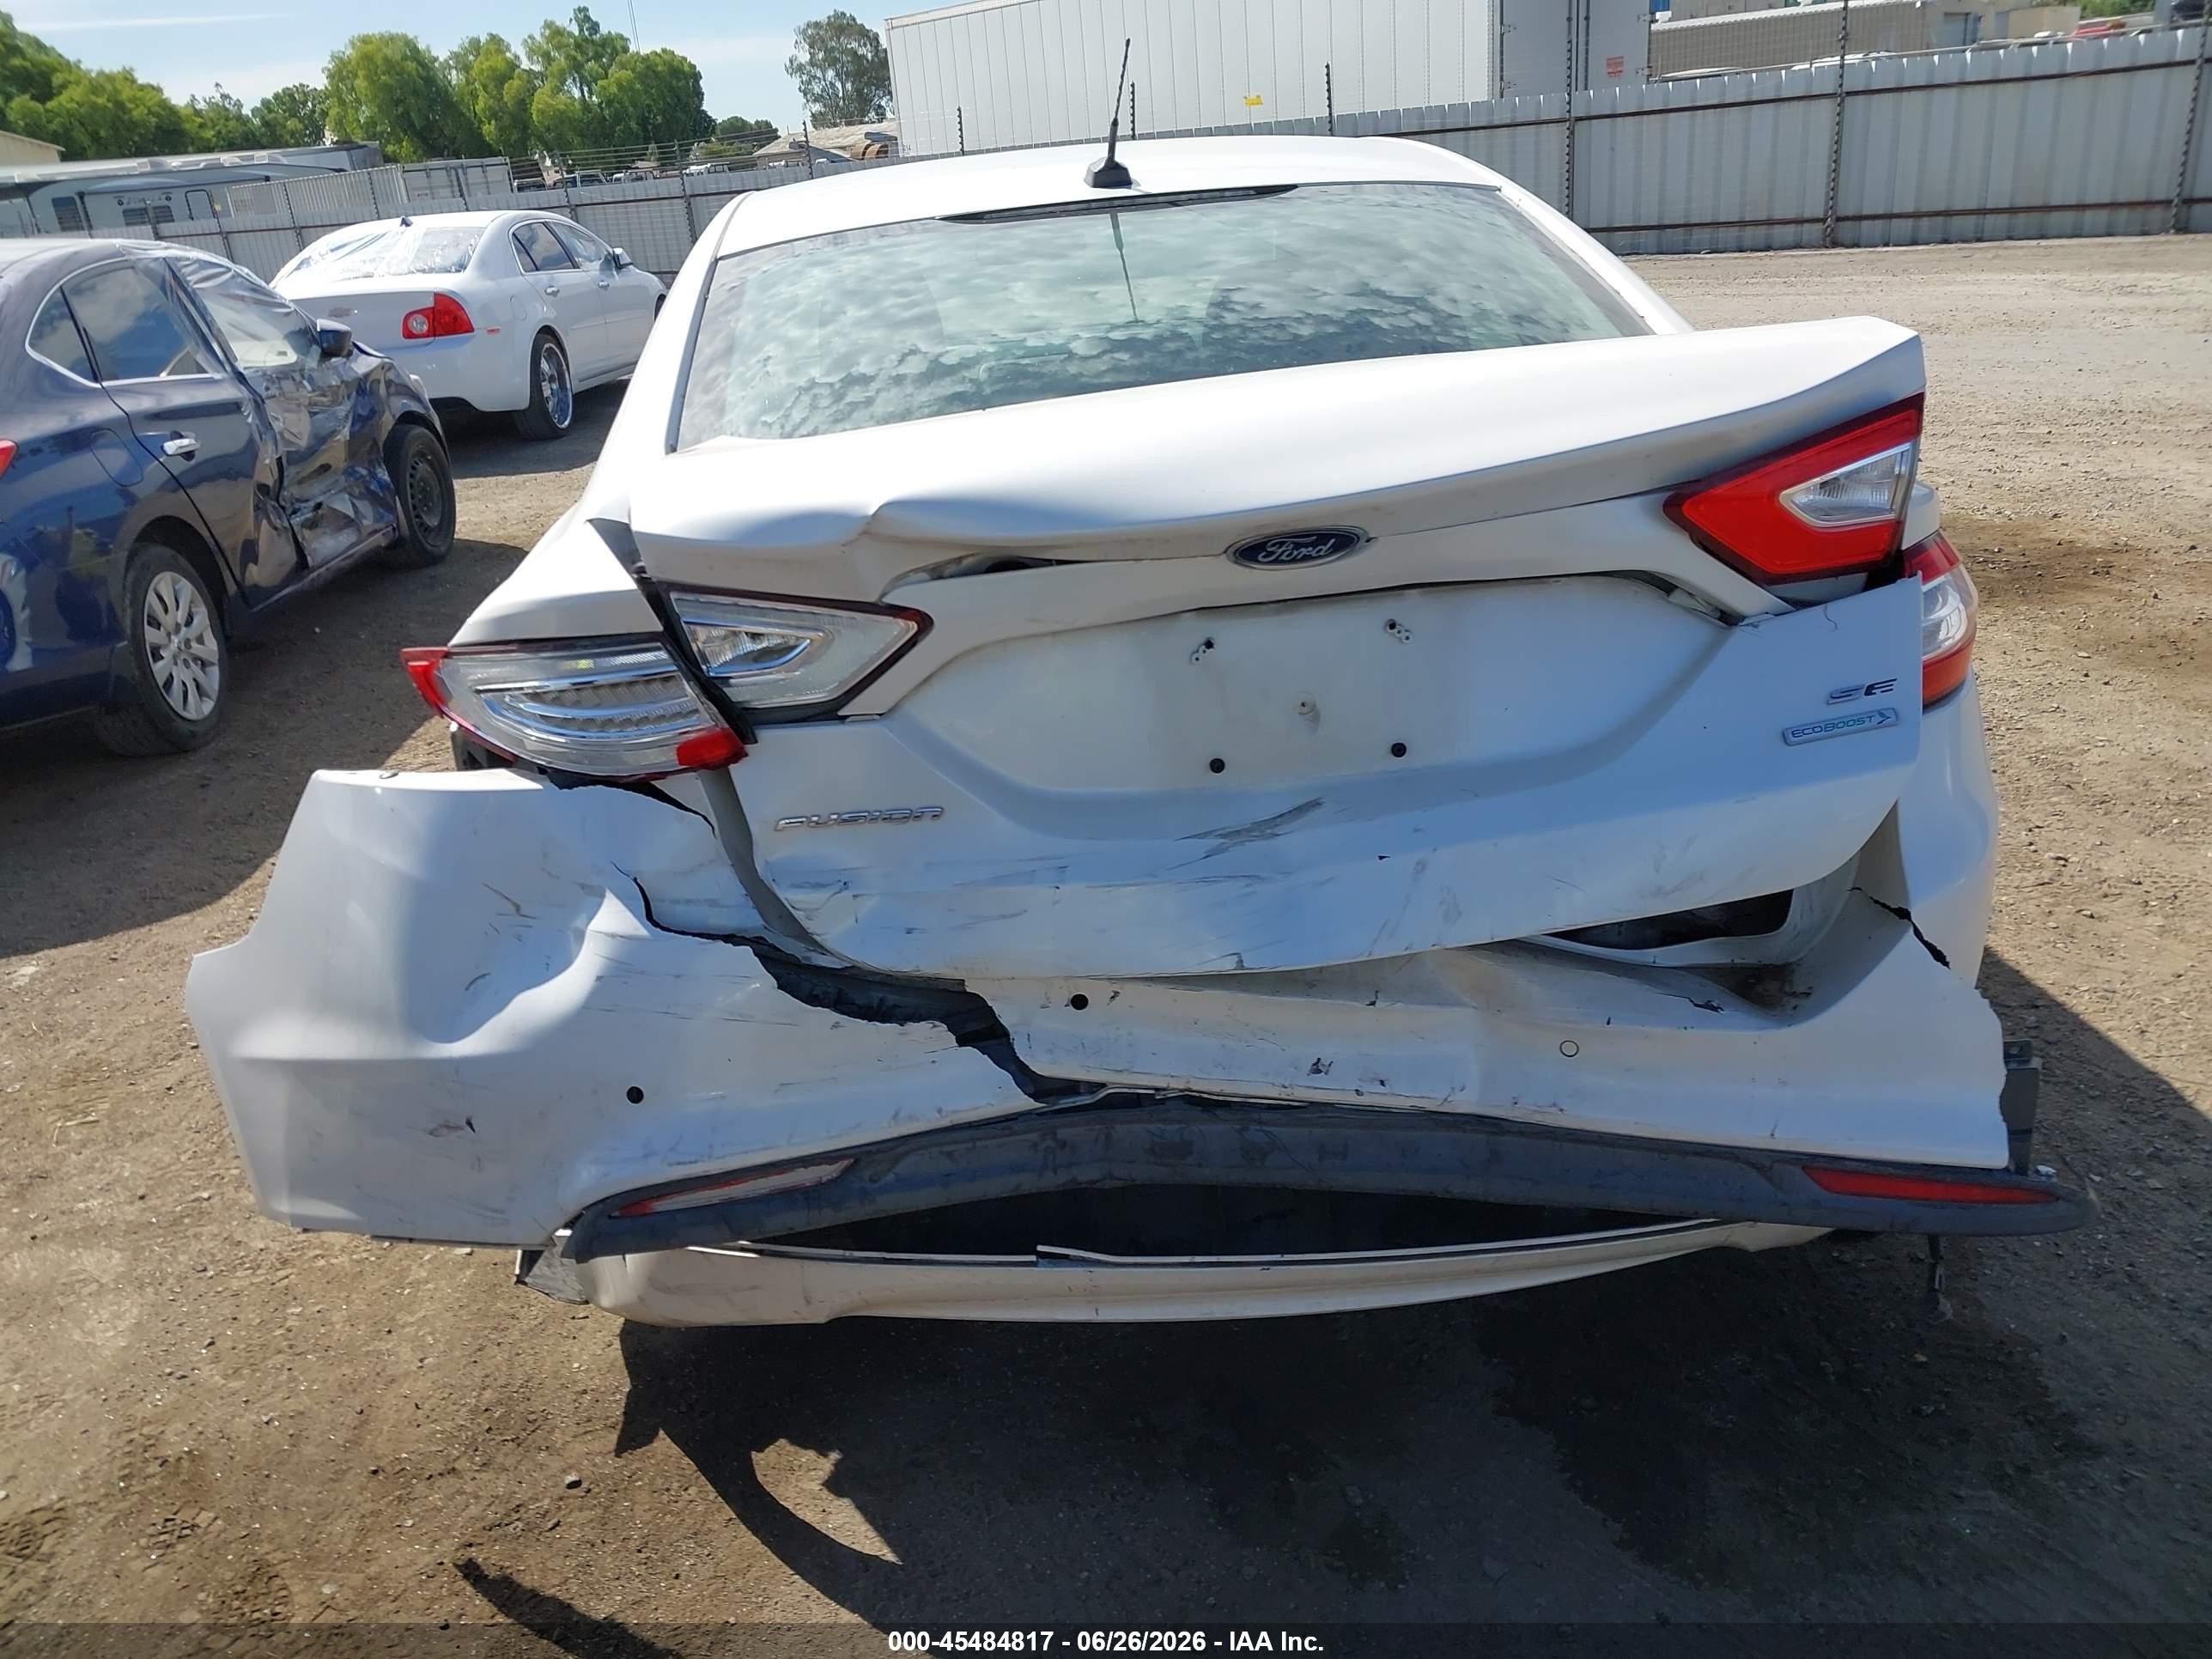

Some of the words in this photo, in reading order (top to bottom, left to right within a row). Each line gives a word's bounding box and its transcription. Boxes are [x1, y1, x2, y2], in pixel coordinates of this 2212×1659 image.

[1258, 536, 1335, 562] Ford
[1826, 677, 1898, 706] SE
[1791, 714, 1875, 738] ECOBOOST
